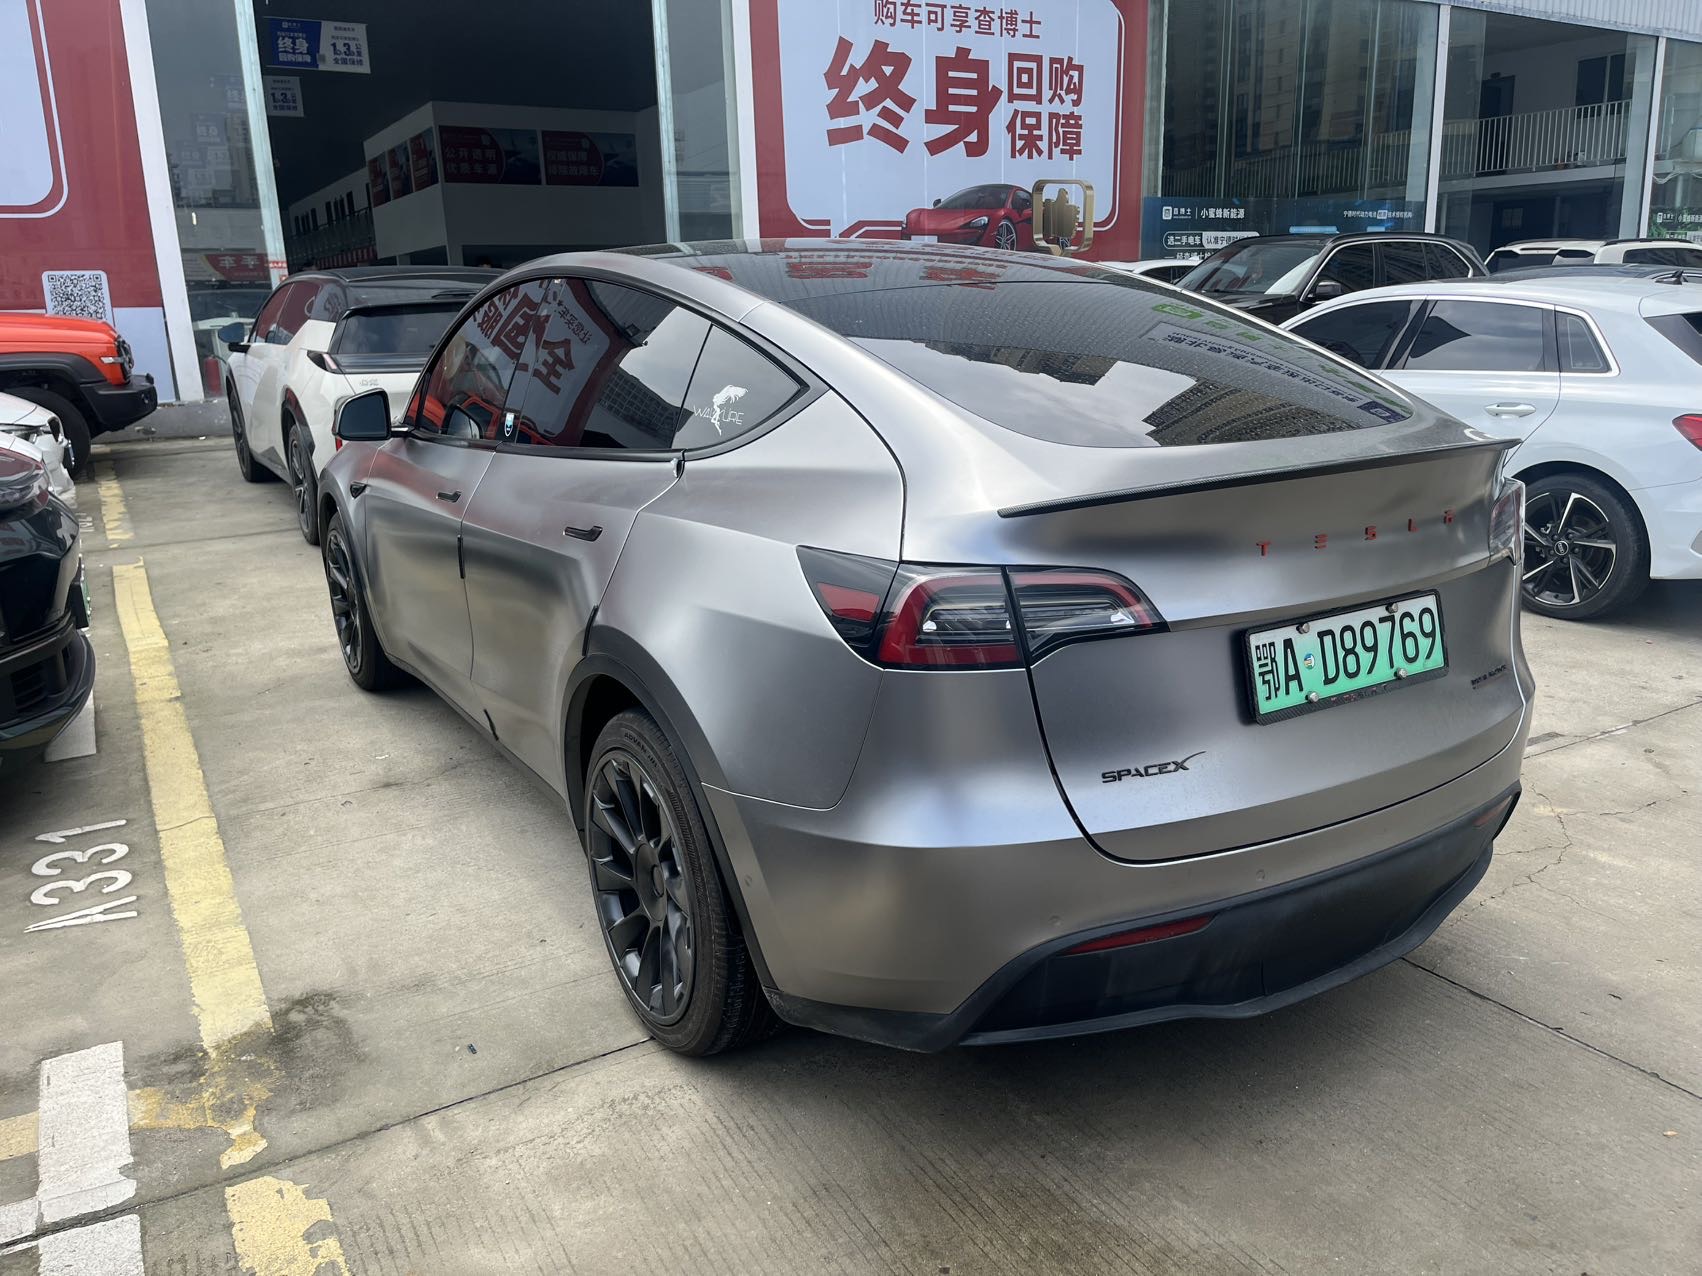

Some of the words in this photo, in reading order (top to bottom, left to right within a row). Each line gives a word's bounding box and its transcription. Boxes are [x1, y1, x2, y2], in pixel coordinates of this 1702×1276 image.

[873, 0, 1042, 39] 购车可享查博士
[278, 37, 308, 53] 终身
[823, 35, 1004, 158] 终身
[1006, 52, 1085, 108] 回购
[1005, 107, 1083, 161] 保障
[1200, 207, 1245, 219] 小蜜蜂新能源
[1167, 234, 1201, 246] 选二手电车
[1256, 509, 1456, 557] TESLA
[1101, 750, 1207, 783] SPACEX
